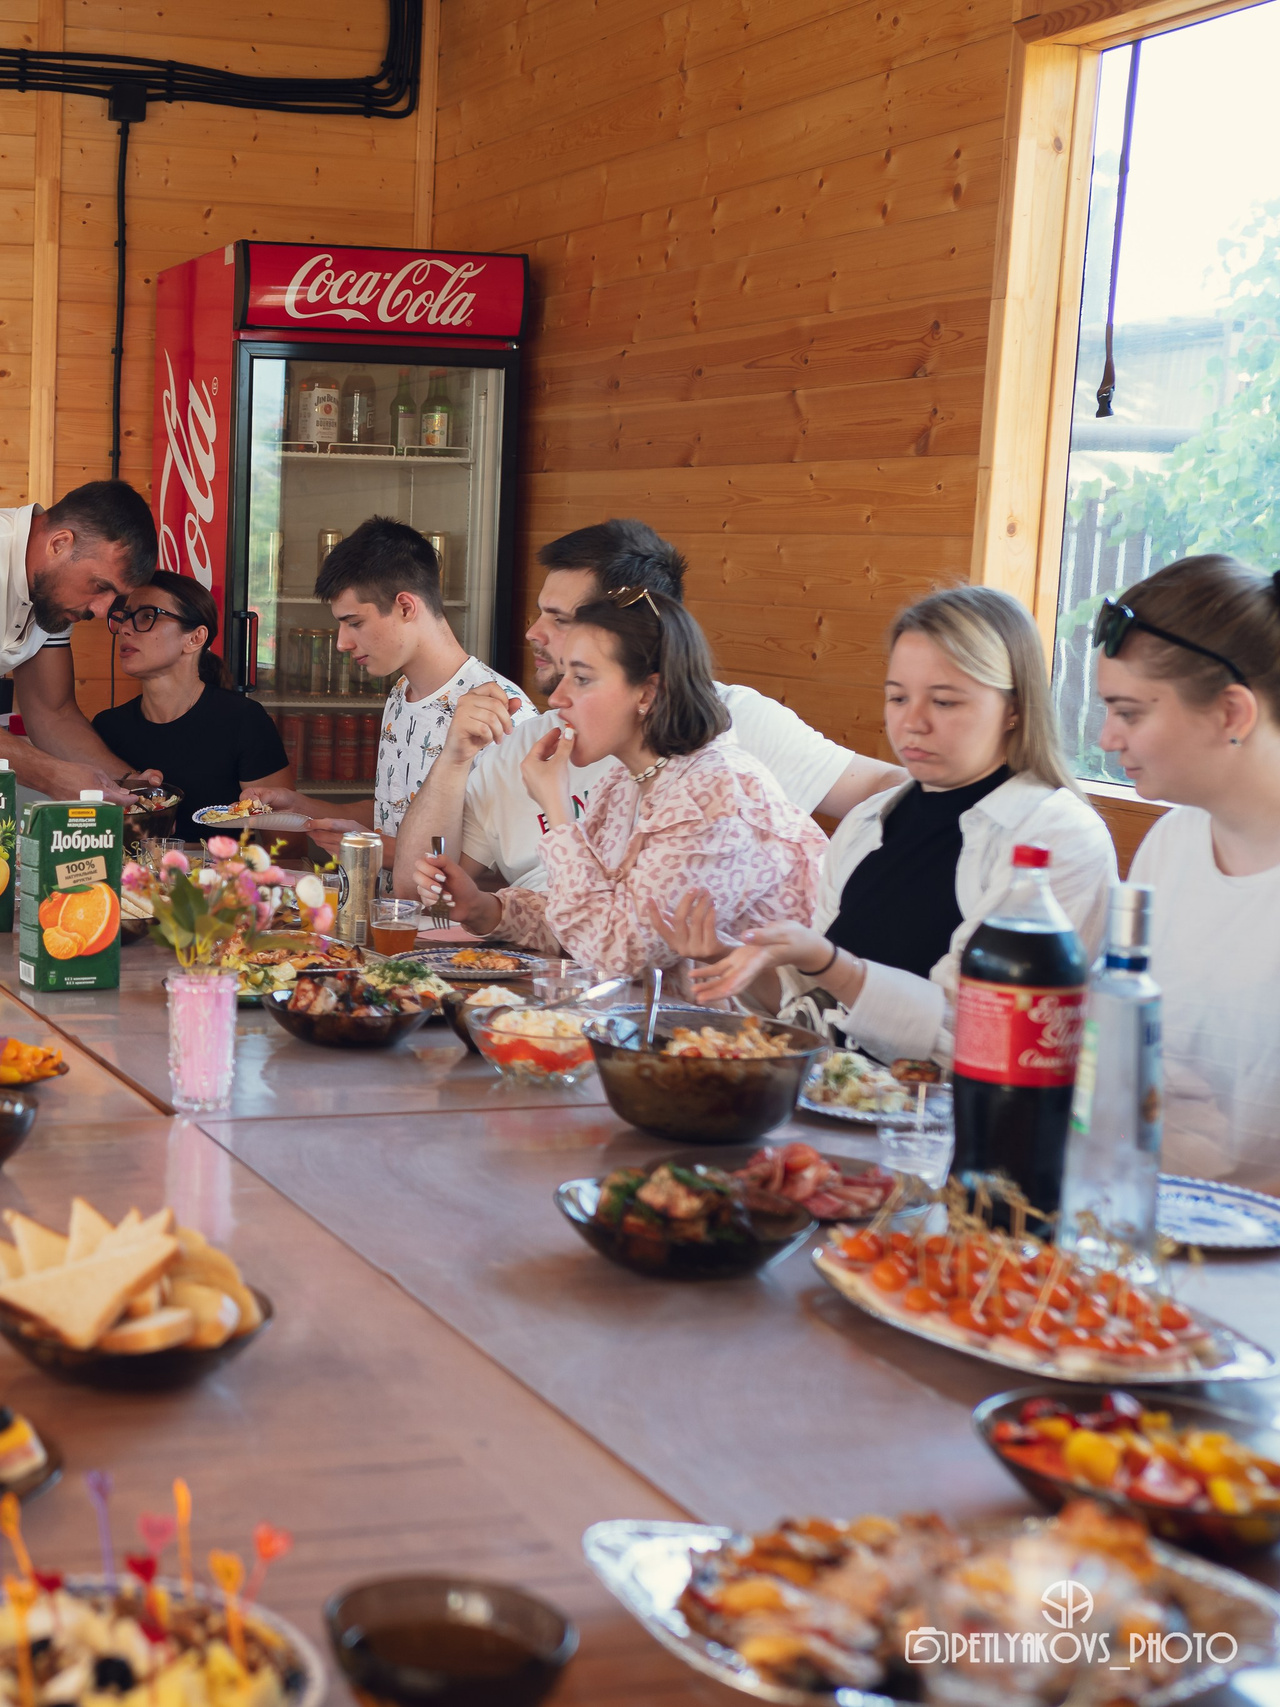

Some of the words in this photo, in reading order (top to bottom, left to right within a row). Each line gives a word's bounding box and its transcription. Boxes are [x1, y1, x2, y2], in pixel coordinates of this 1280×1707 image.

[284, 253, 486, 326] Coca-Cola
[50, 829, 114, 853] Добрый
[65, 859, 96, 875] 100%
